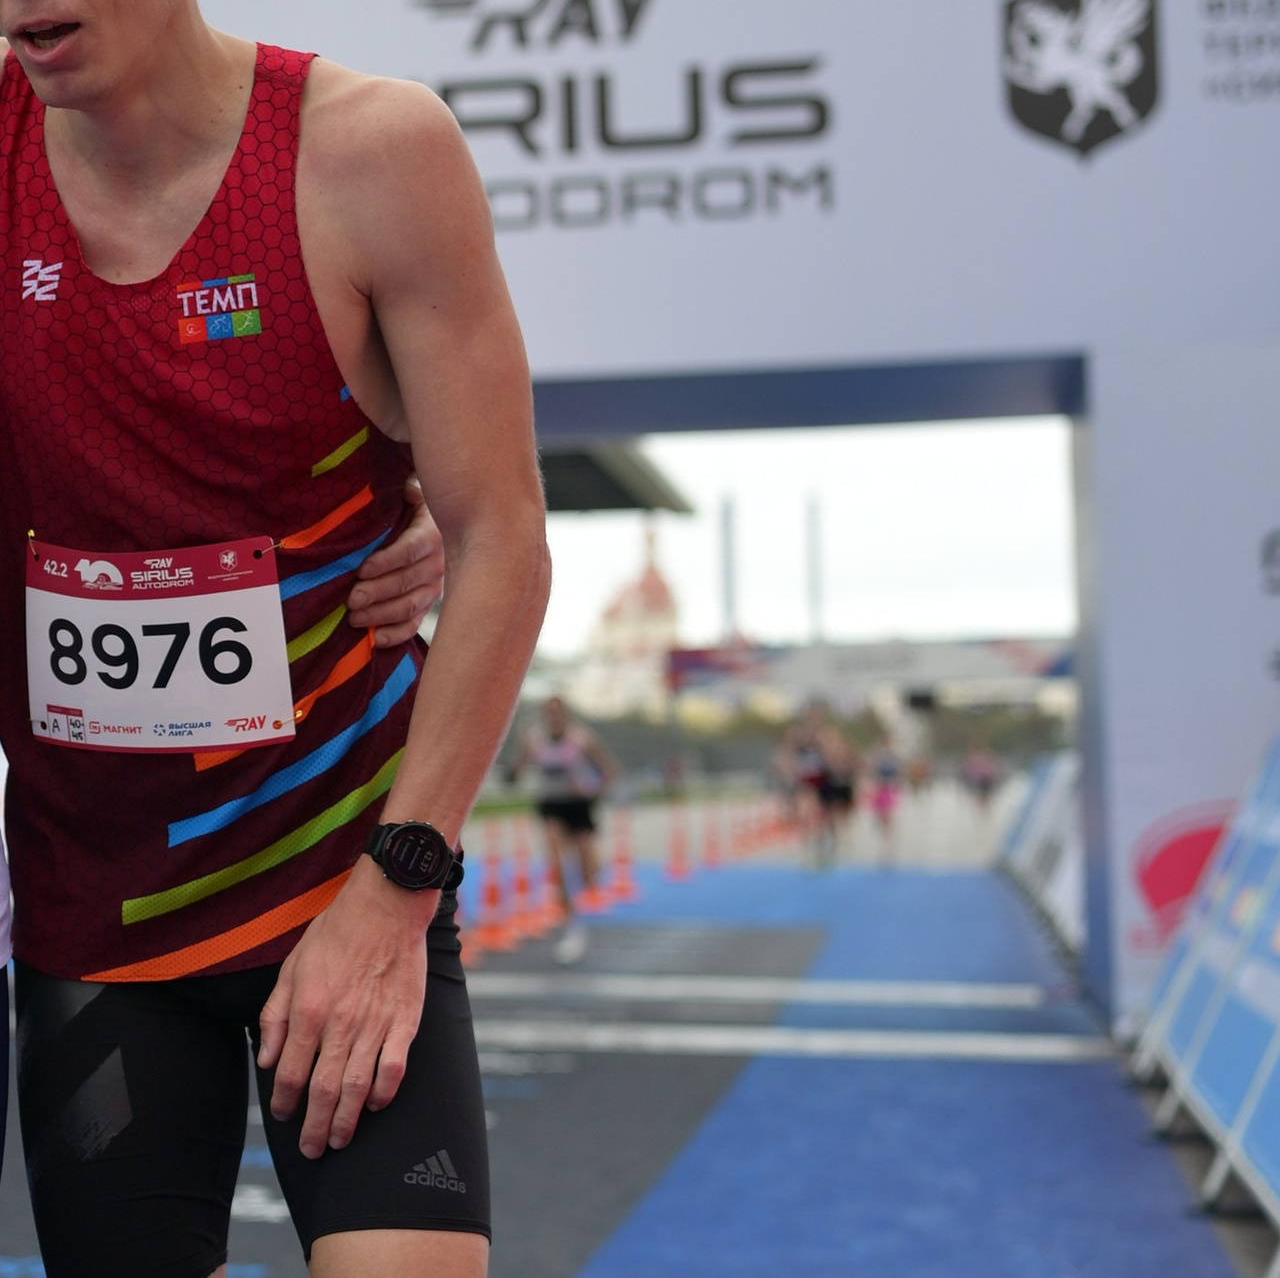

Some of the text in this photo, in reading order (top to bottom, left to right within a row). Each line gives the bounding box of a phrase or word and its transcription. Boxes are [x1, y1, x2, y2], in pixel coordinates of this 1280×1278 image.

[442, 57, 833, 156] RIUS
[488, 166, 833, 229] ODROM
[177, 283, 258, 317] ТЕМП
[43, 559, 68, 578] 42.2
[130, 567, 194, 583] SIRIUS
[131, 578, 194, 590] AUTODROM
[48, 616, 253, 690] 8976
[103, 724, 143, 734] МАГНИТ
[168, 721, 211, 730] ВЫСШАЯ
[168, 729, 194, 737] ЛИГА
[403, 1171, 466, 1193] adidas
